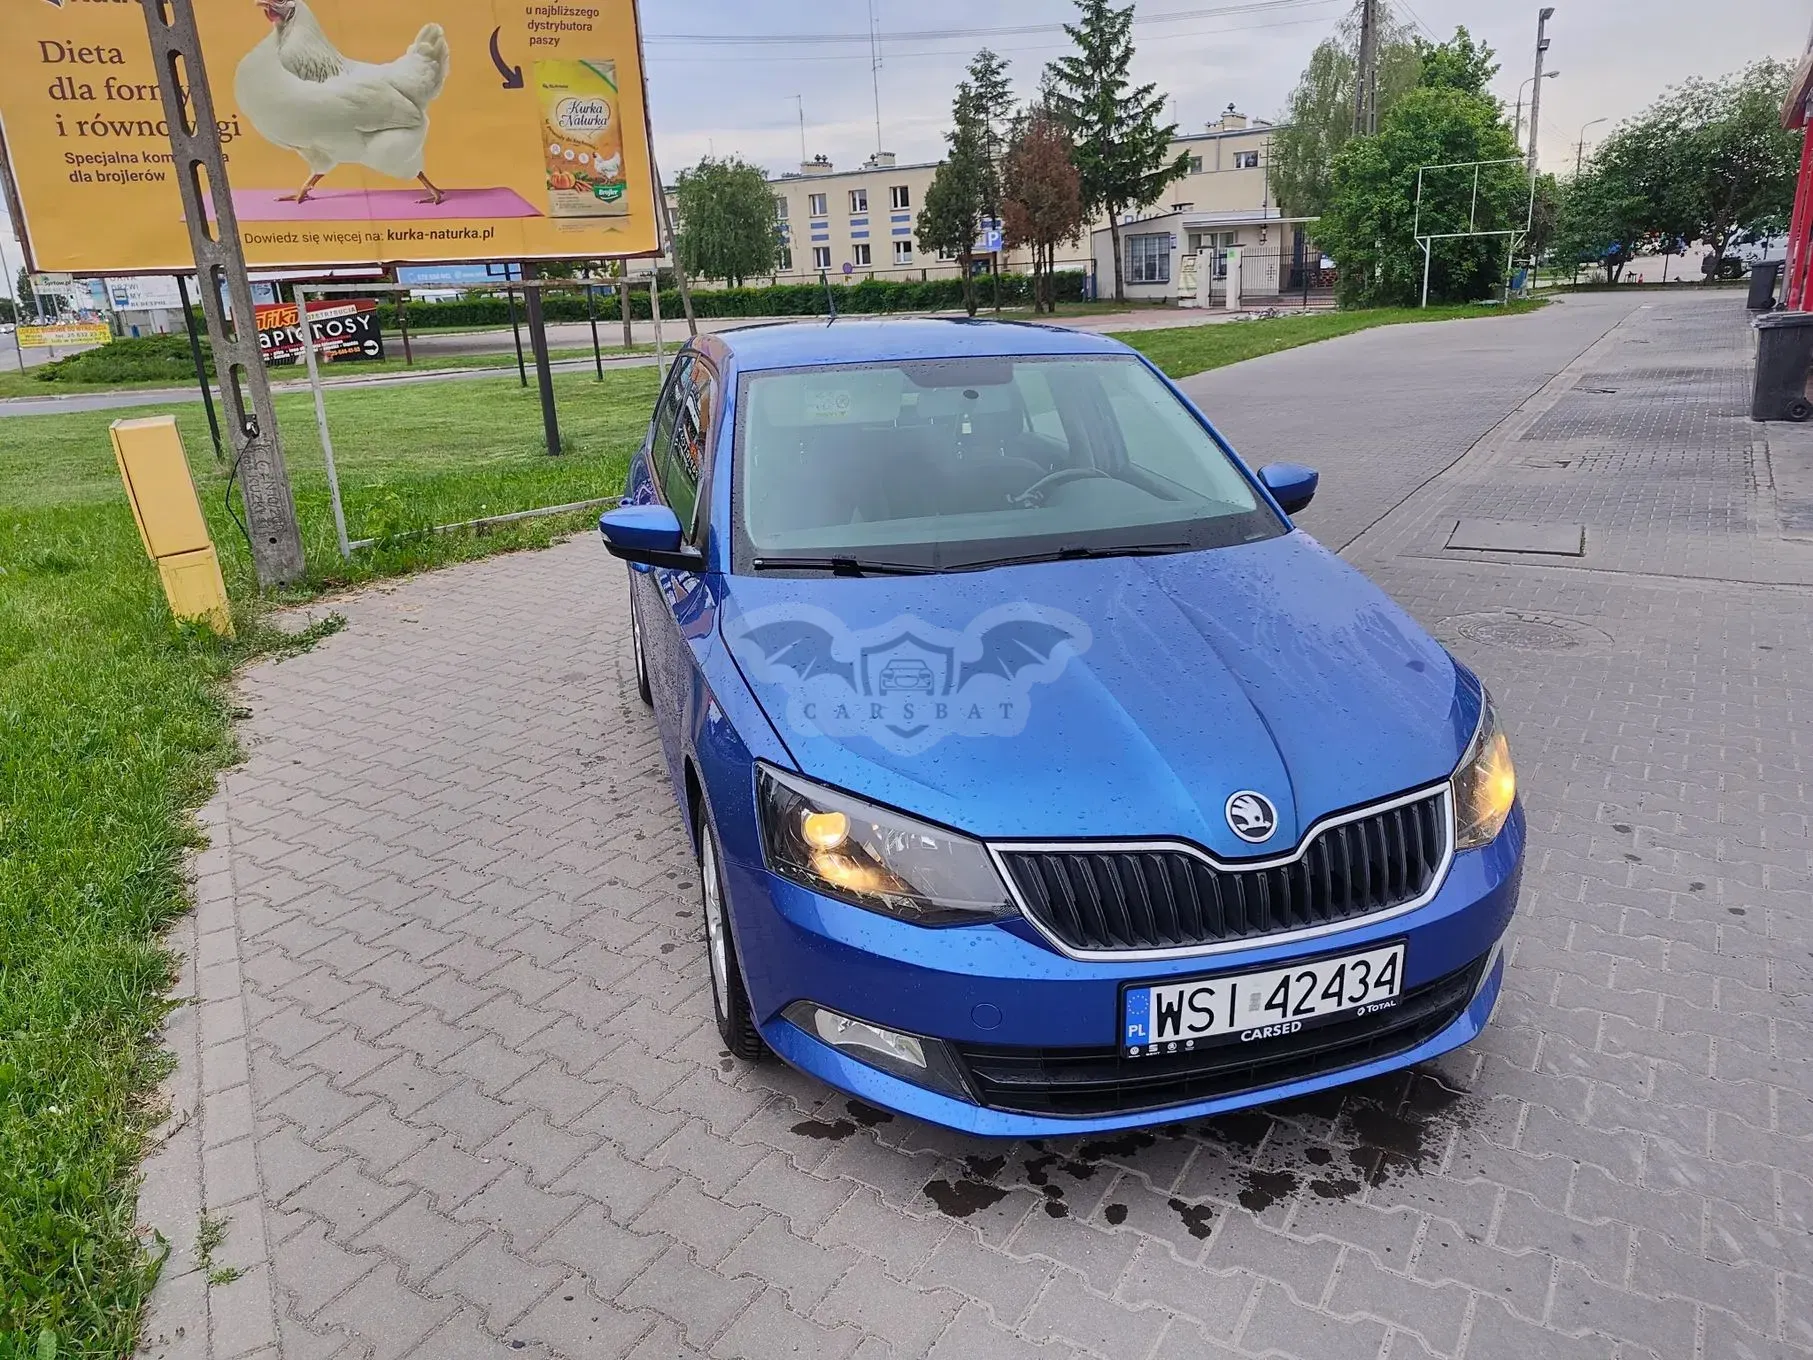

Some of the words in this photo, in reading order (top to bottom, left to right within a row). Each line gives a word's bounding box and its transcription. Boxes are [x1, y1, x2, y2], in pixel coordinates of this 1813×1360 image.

[525, 6, 532, 15] u
[535, 5, 600, 19] najbliższego
[527, 19, 593, 32] dystrybutora
[529, 36, 561, 47] paszy
[38, 39, 126, 65] Dieta
[48, 76, 97, 101] dla
[568, 100, 603, 114] Kurka
[55, 113, 68, 137] i
[64, 151, 139, 167] Specjalna
[69, 168, 93, 183] dla
[96, 168, 165, 185] brojlerów
[244, 232, 298, 244] Dowiedz
[302, 232, 320, 244] się
[323, 231, 362, 245] więcej
[365, 232, 384, 242] na:
[387, 226, 495, 242] kurka-naturka.pl
[1156, 983, 1238, 1038] WSI
[1263, 951, 1399, 1019] 42434
[1366, 1000, 1397, 1013] TOTAL
[1128, 1024, 1146, 1038] PL
[1240, 1021, 1302, 1042] CARSED
